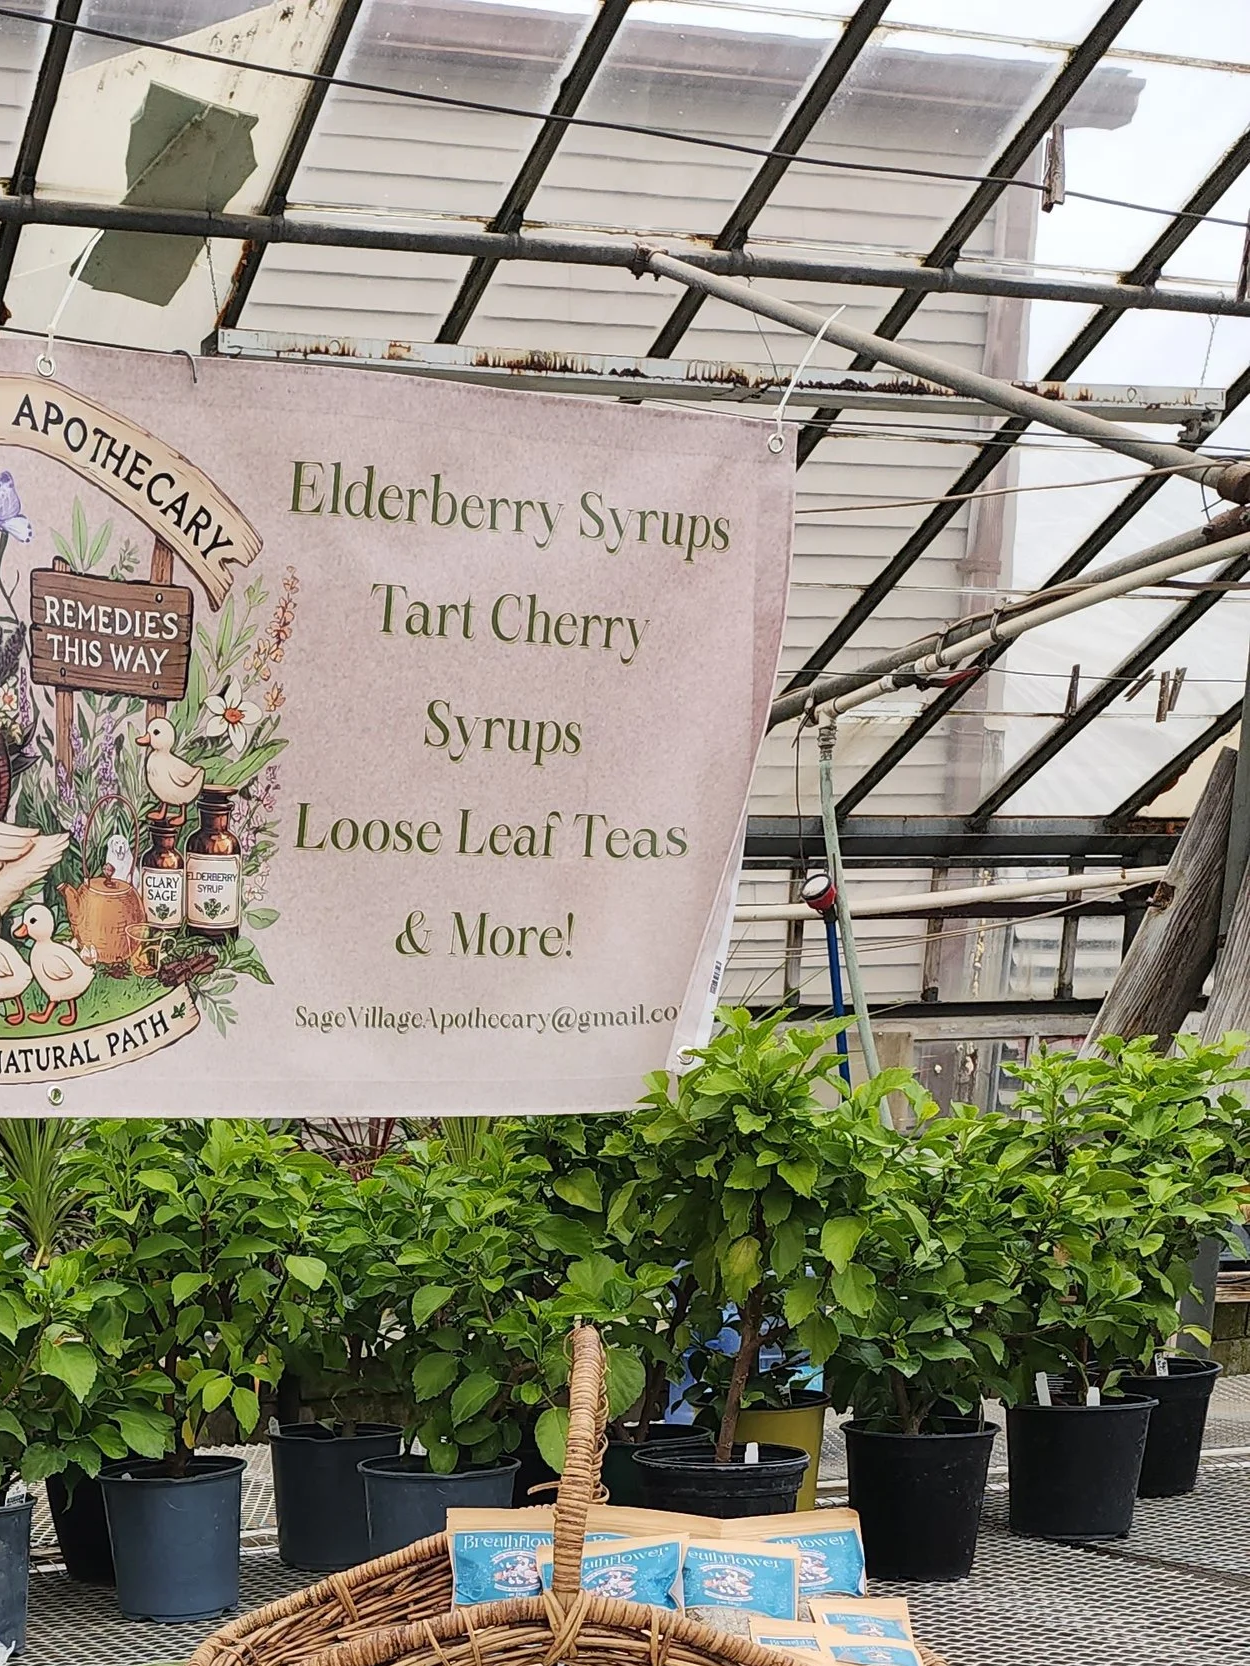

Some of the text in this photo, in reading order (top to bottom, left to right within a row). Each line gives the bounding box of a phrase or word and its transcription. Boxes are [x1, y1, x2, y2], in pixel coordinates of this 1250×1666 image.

[12, 394, 234, 561] APOTHECARY
[288, 460, 731, 563] Elderberry Syrups
[45, 595, 180, 640] REMEDIES
[371, 582, 650, 665] Tart Cherry
[46, 634, 170, 676] THIS WAY
[423, 700, 583, 767] Syrups
[294, 802, 689, 860] Loose Leaf Teas
[145, 876, 180, 889] CLARY
[147, 889, 178, 902] SAGE
[197, 884, 224, 893] SYRUP
[395, 909, 576, 960] & More!
[105, 1010, 172, 1060] PATH
[294, 1002, 683, 1036] SageVillageApothecary@gmail.co
[463, 1534, 552, 1549] Breathflow
